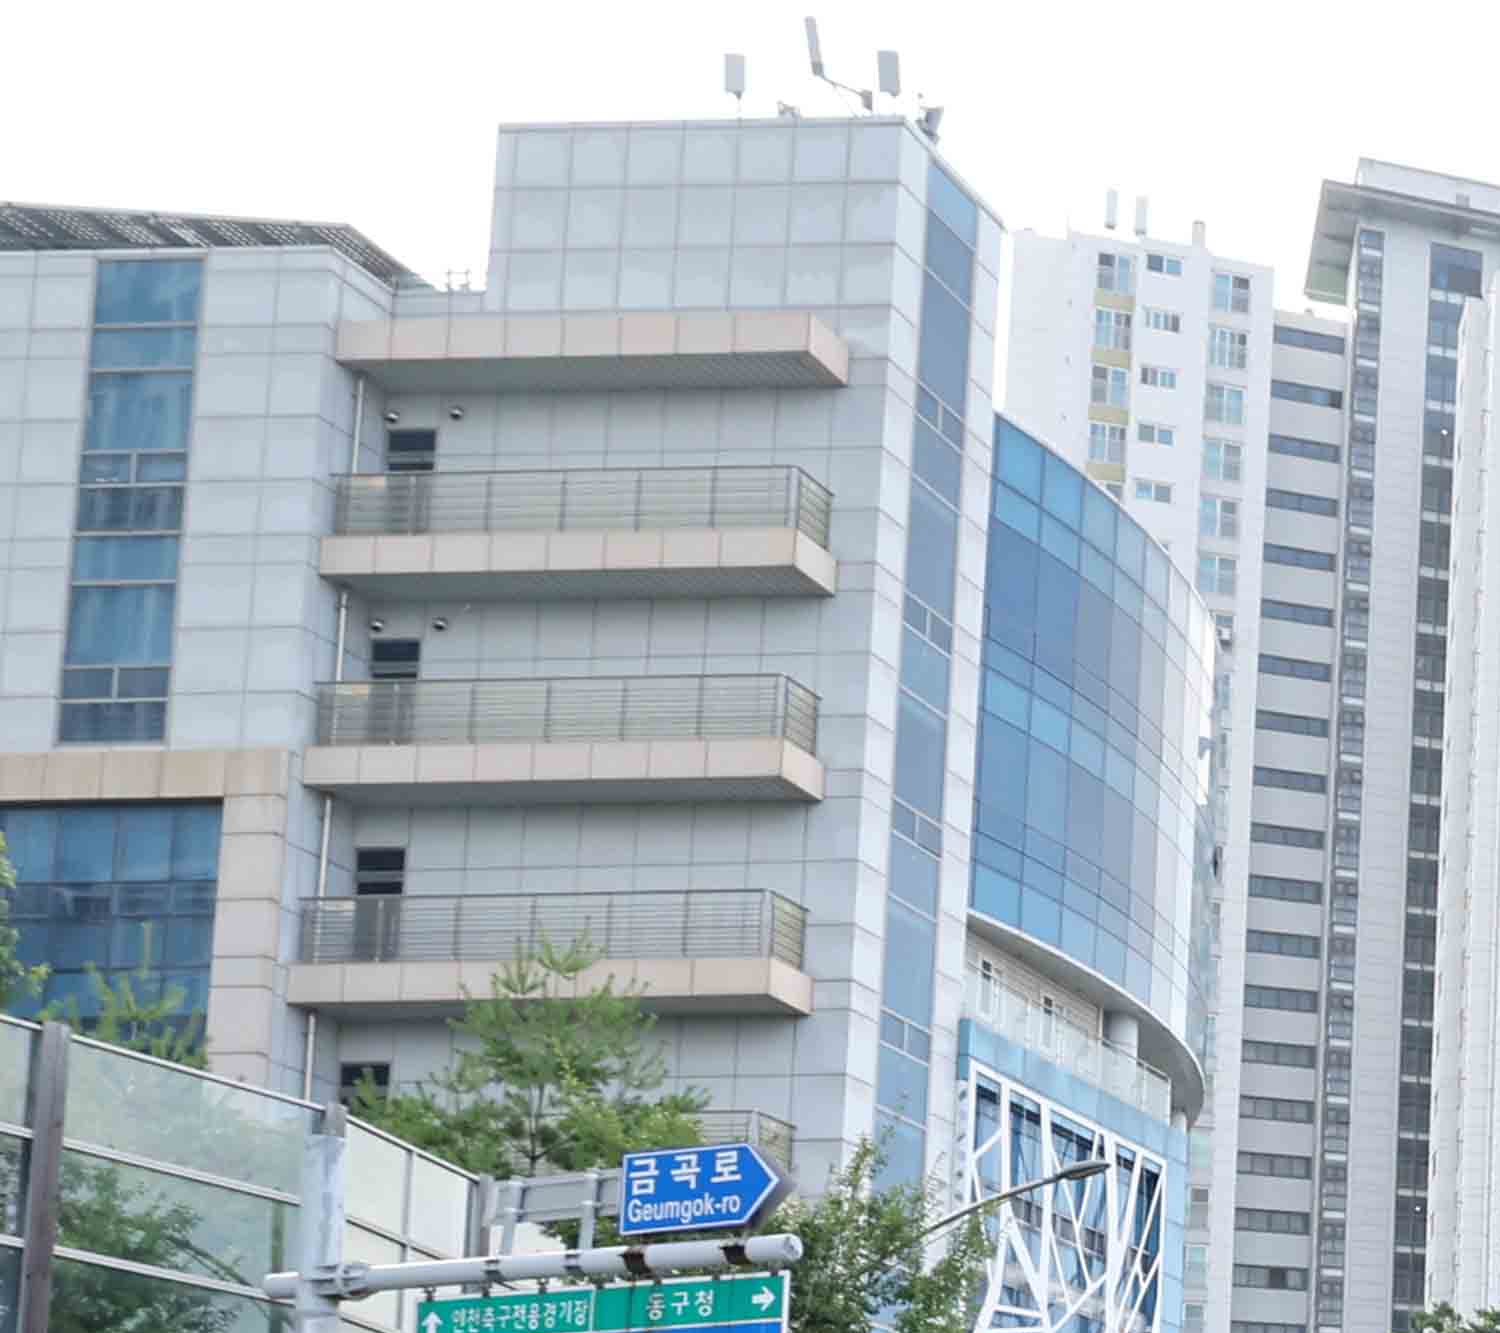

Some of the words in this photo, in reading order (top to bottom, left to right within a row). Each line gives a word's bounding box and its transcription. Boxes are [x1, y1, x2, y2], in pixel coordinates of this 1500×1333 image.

[627, 1151, 741, 1195] 금곡로
[627, 1194, 741, 1227] Geumgok-ro
[645, 1288, 716, 1322] 동구청
